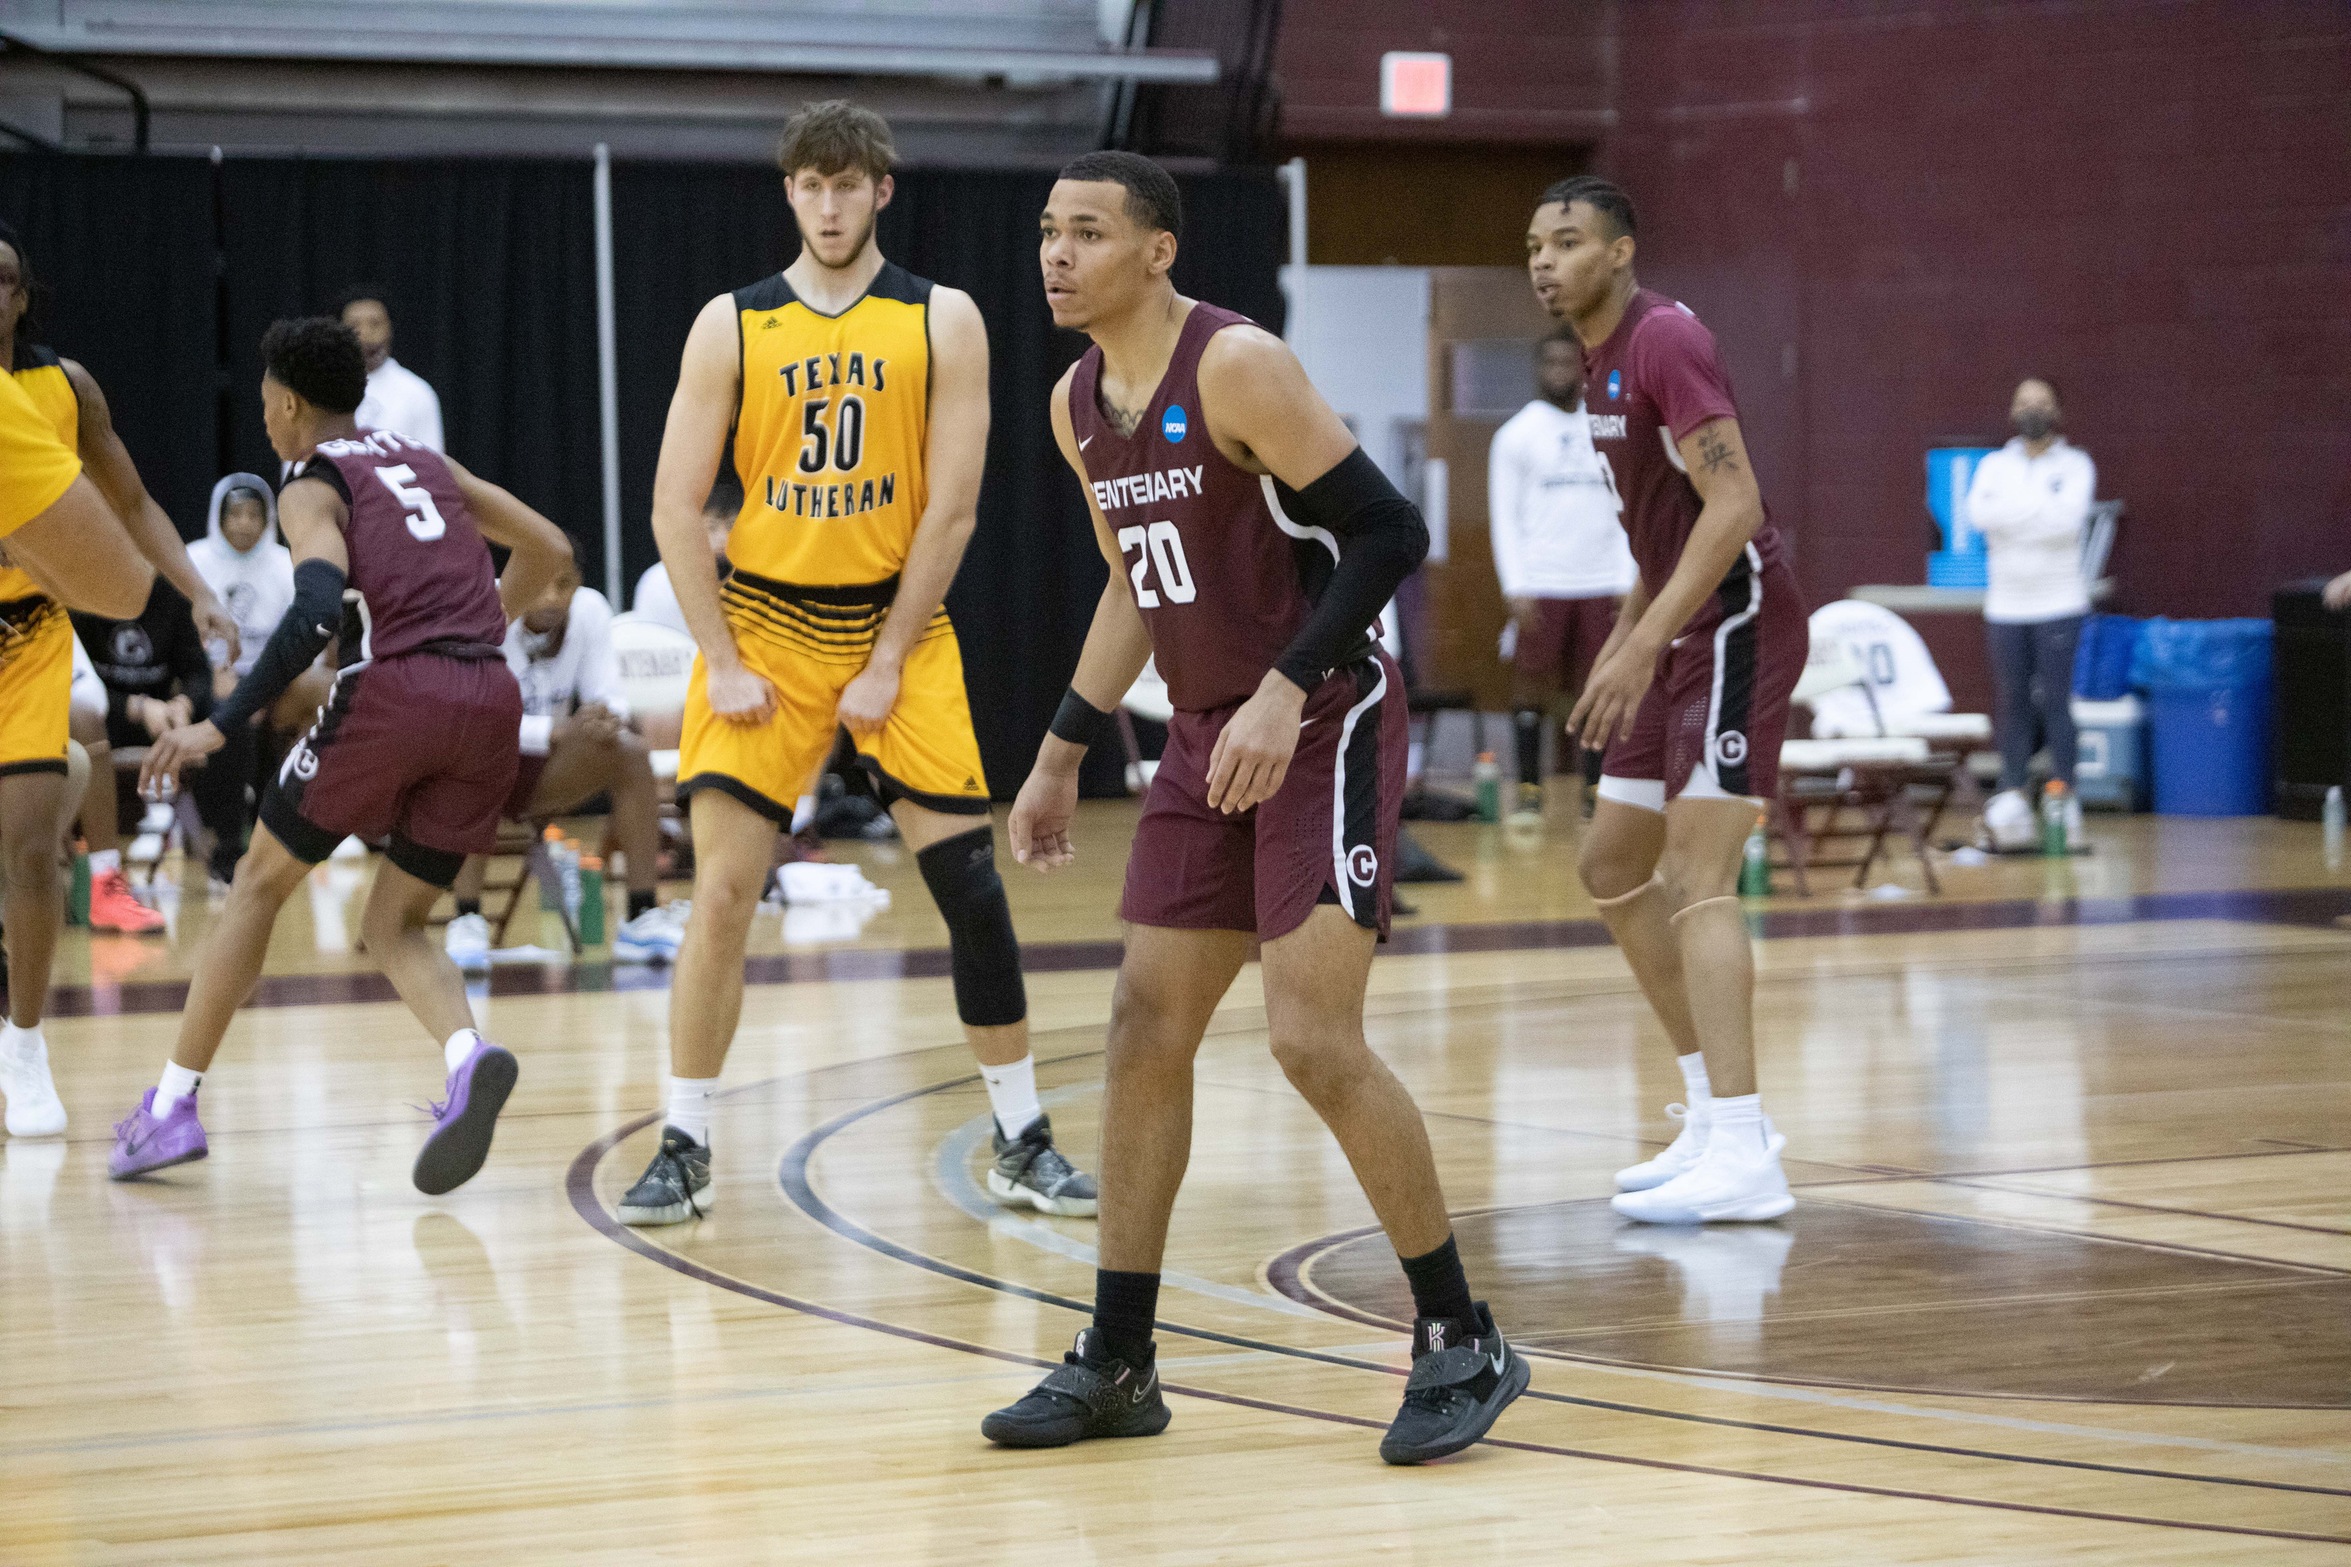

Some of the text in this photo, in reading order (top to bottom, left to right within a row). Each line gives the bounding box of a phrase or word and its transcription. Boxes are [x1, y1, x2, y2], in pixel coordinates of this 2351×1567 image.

[779, 351, 889, 398] TEXAS
[795, 393, 866, 477] 50
[1164, 422, 1186, 434] NCAA
[374, 463, 447, 542] 5
[765, 471, 896, 519] LUTHERAN
[1090, 464, 1204, 511] ENTEARY
[1117, 520, 1197, 609] 20
